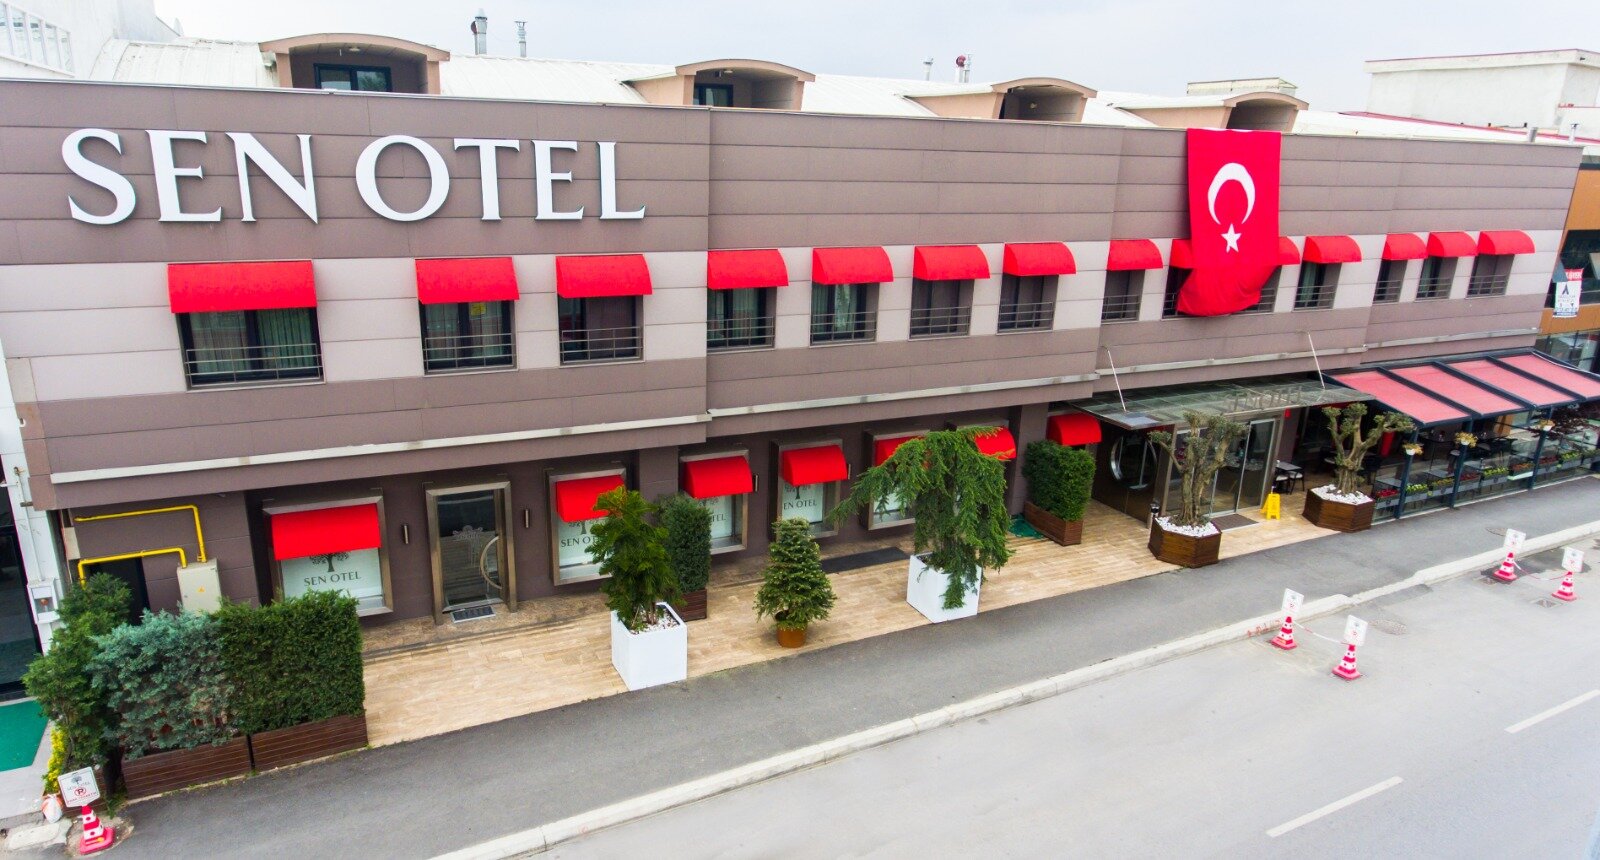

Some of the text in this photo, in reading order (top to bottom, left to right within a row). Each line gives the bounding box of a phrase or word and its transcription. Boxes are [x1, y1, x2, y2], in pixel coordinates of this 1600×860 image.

[61, 128, 646, 225] SEN OTEL
[783, 499, 817, 510] EN OTEL
[712, 514, 727, 522] TEL
[560, 537, 580, 548] SEN
[304, 572, 361, 586] SEN OTEL
